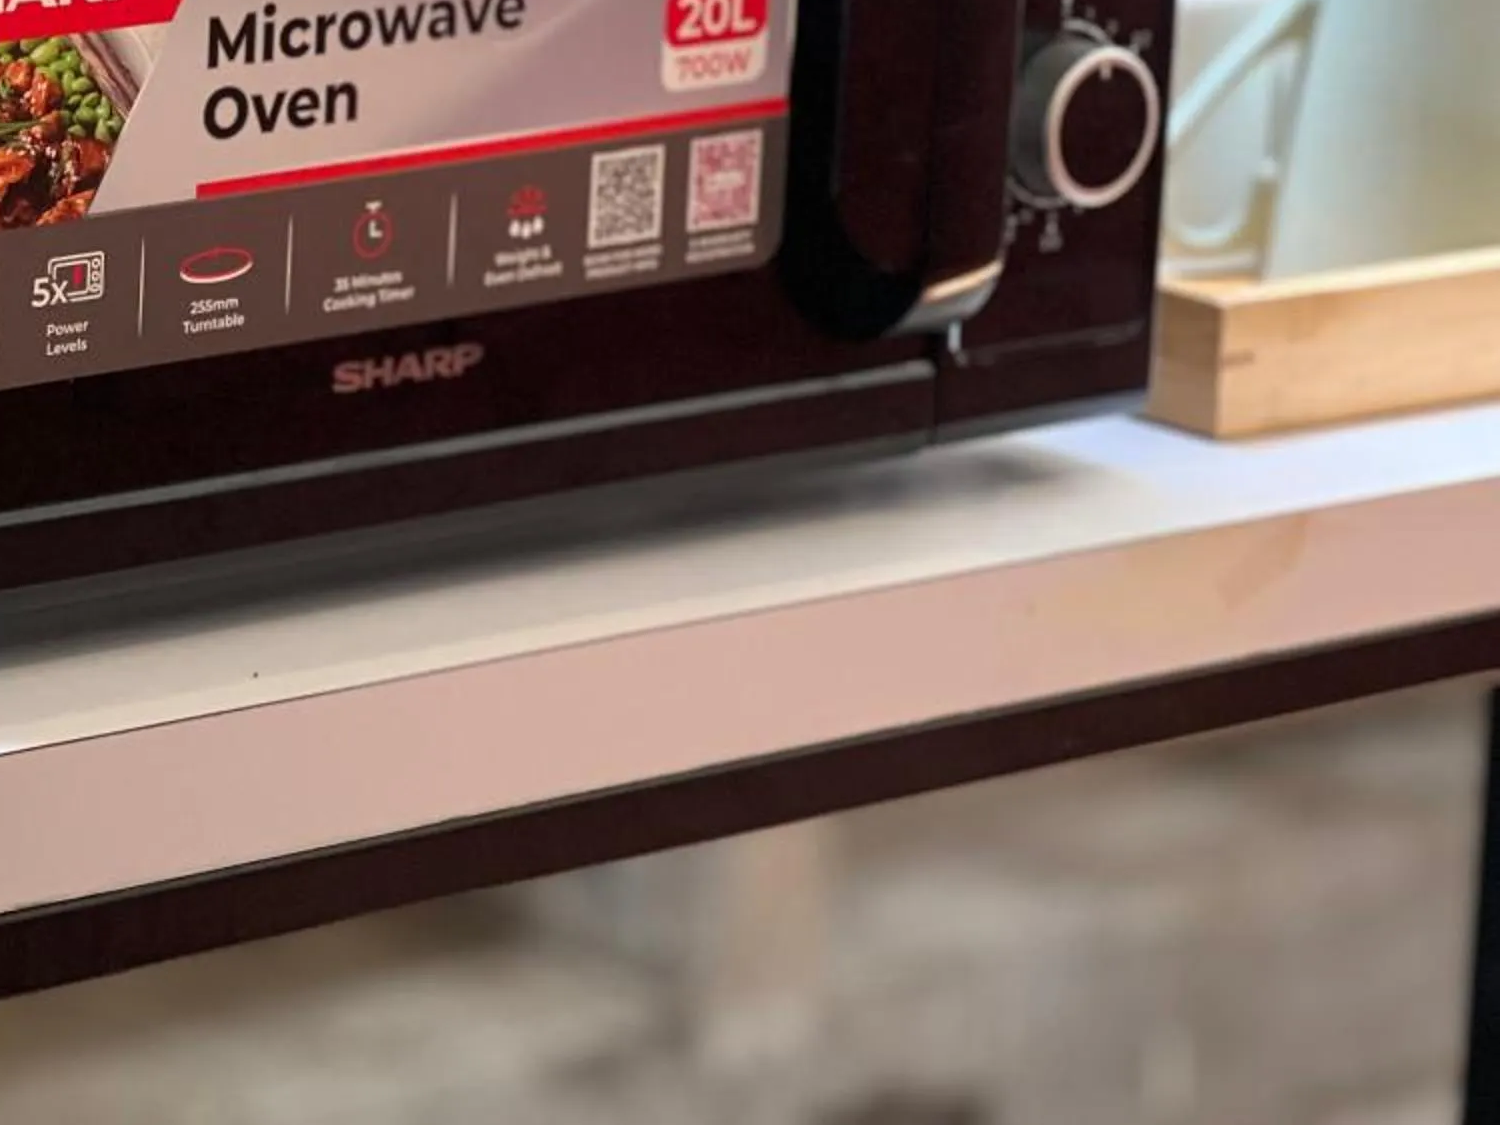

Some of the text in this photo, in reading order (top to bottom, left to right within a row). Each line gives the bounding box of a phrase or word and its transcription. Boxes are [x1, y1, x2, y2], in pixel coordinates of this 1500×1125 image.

[674, 45, 753, 82] 700W
[203, 80, 359, 140] Oven
[31, 277, 69, 308] 5x
[189, 296, 239, 315] 255mm
[322, 285, 416, 313] Cooking Timer
[45, 319, 89, 338] Power
[182, 312, 245, 335] Turntable
[45, 337, 89, 357] Levels
[331, 342, 486, 394] SHARP
